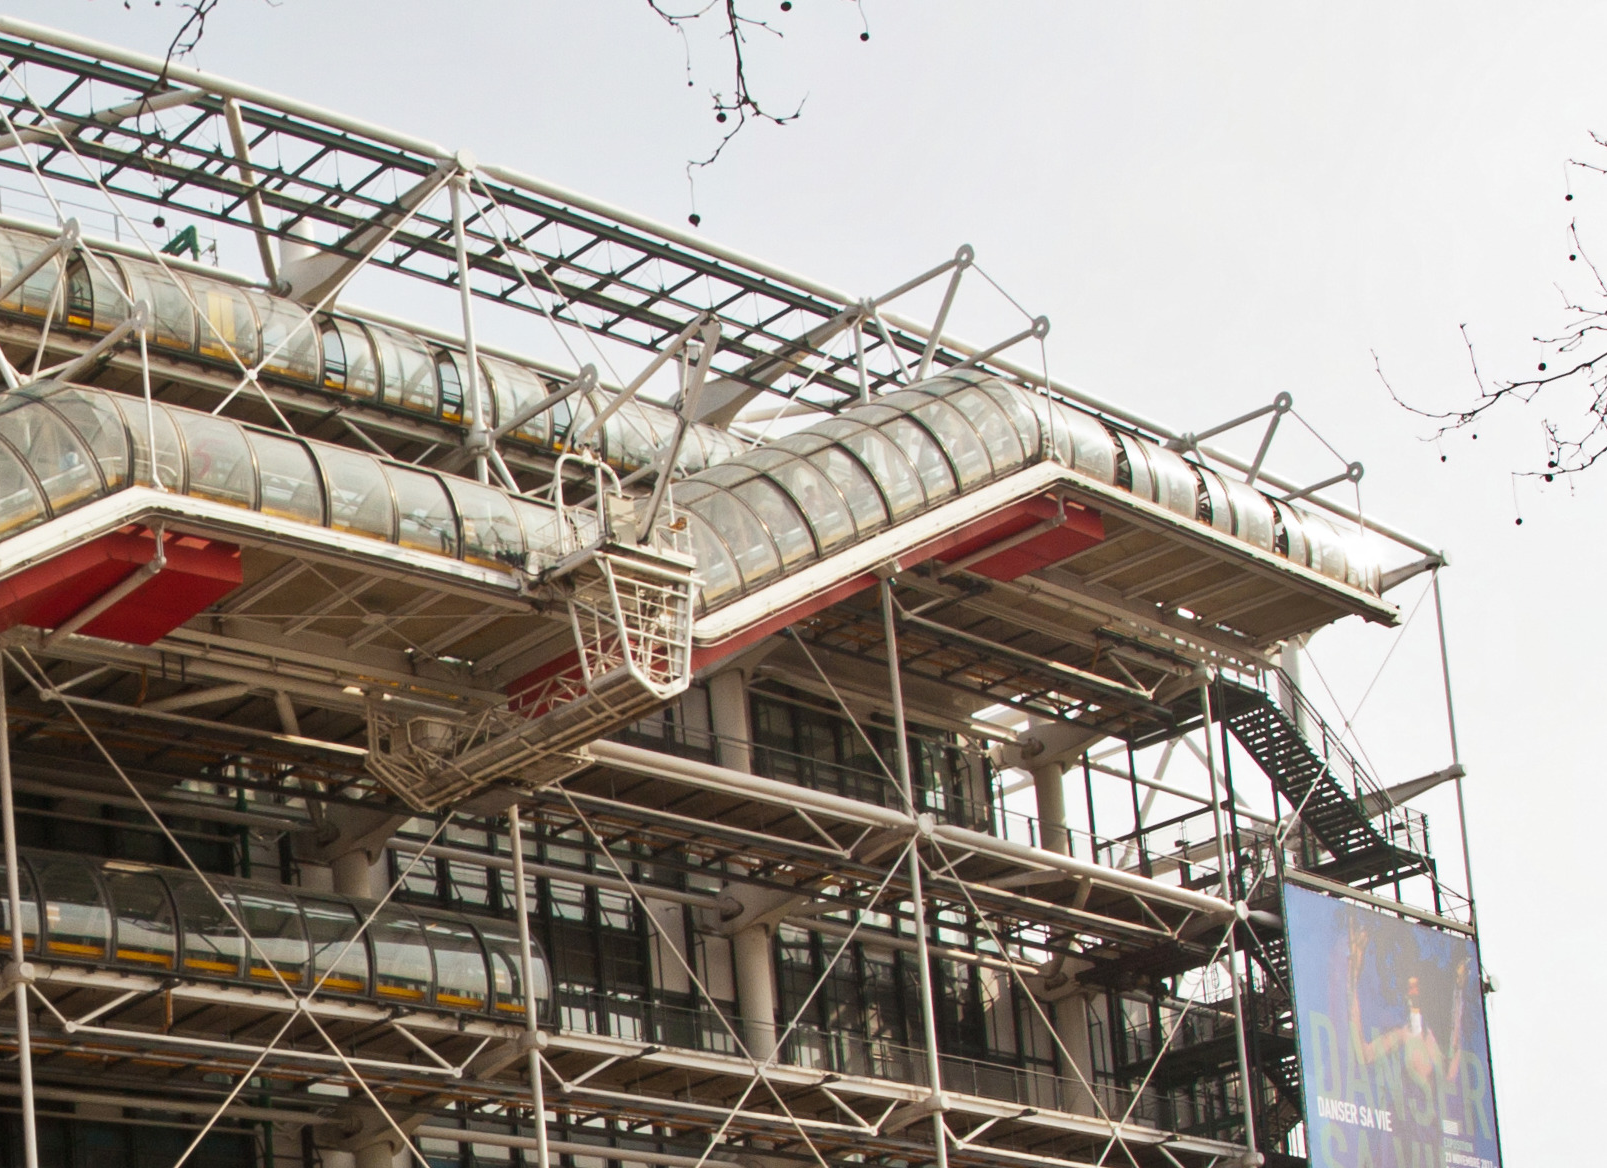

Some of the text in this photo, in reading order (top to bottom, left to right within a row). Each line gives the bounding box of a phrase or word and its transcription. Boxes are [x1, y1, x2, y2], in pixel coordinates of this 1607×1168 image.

[1309, 1010, 1493, 1141] DANSER
[1317, 1095, 1392, 1132] DANSER SA VIE
